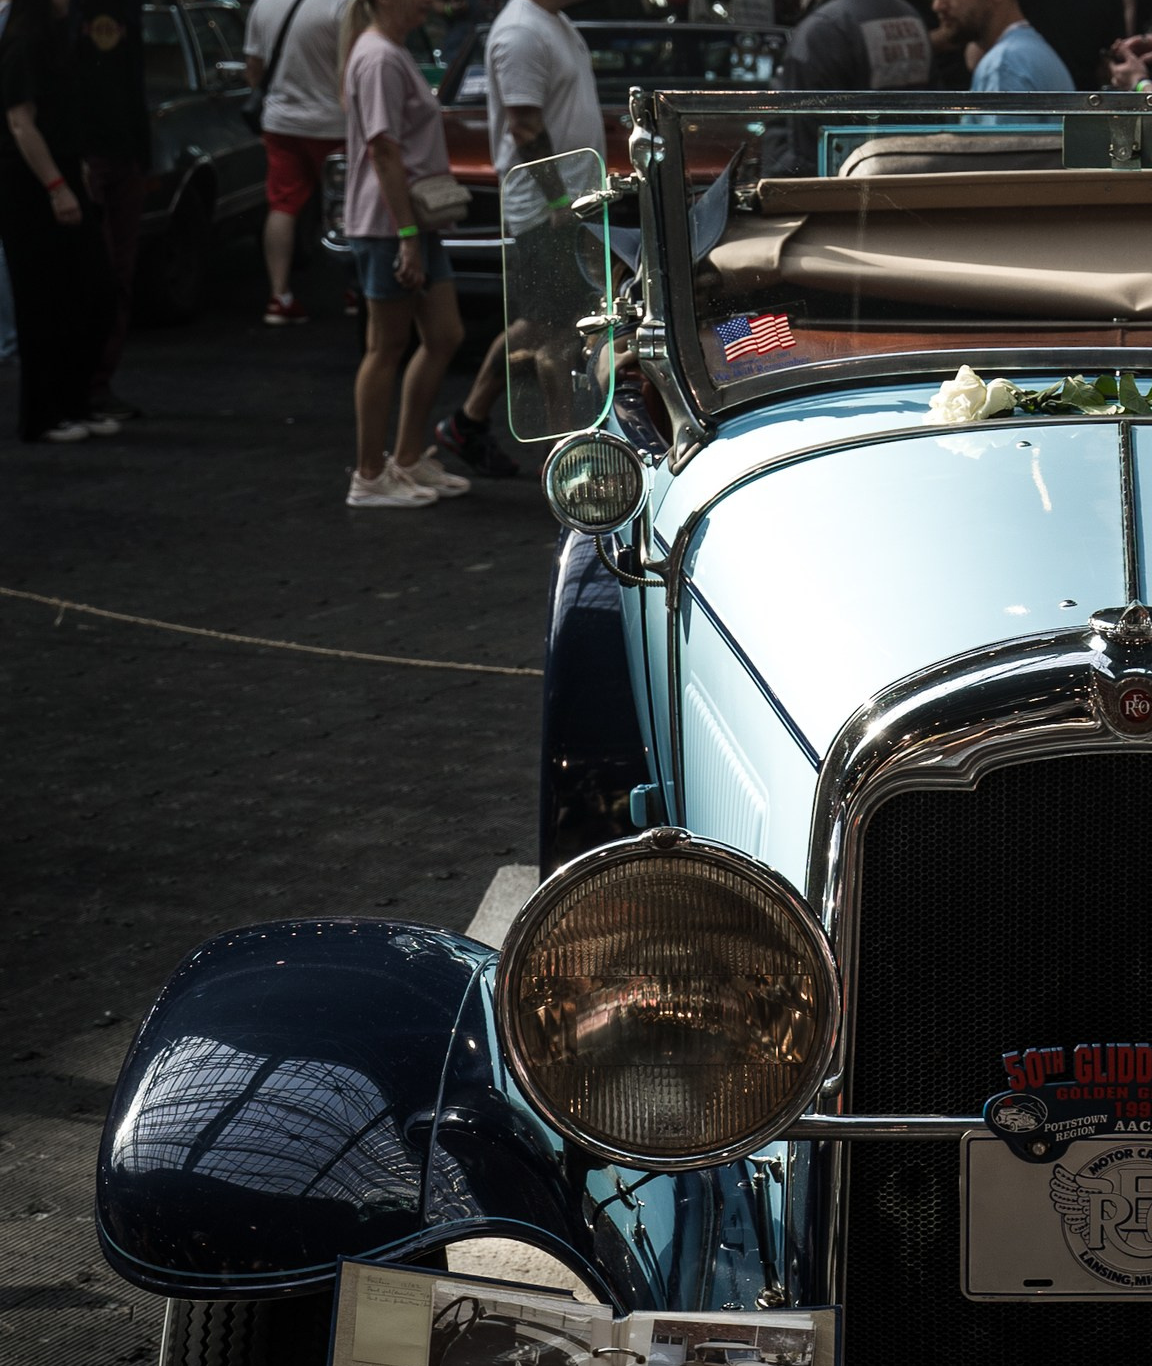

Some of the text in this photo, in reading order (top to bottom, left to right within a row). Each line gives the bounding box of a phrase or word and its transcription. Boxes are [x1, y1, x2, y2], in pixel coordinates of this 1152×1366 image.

[1125, 694, 1150, 718] REO
[1002, 1046, 1066, 1091] 50TH
[1056, 1086, 1129, 1100] GOLDEN
[1044, 1114, 1108, 1132] POTTSTOWN
[1055, 1125, 1096, 1142] REGION
[1088, 1148, 1134, 1175] MOTOR
